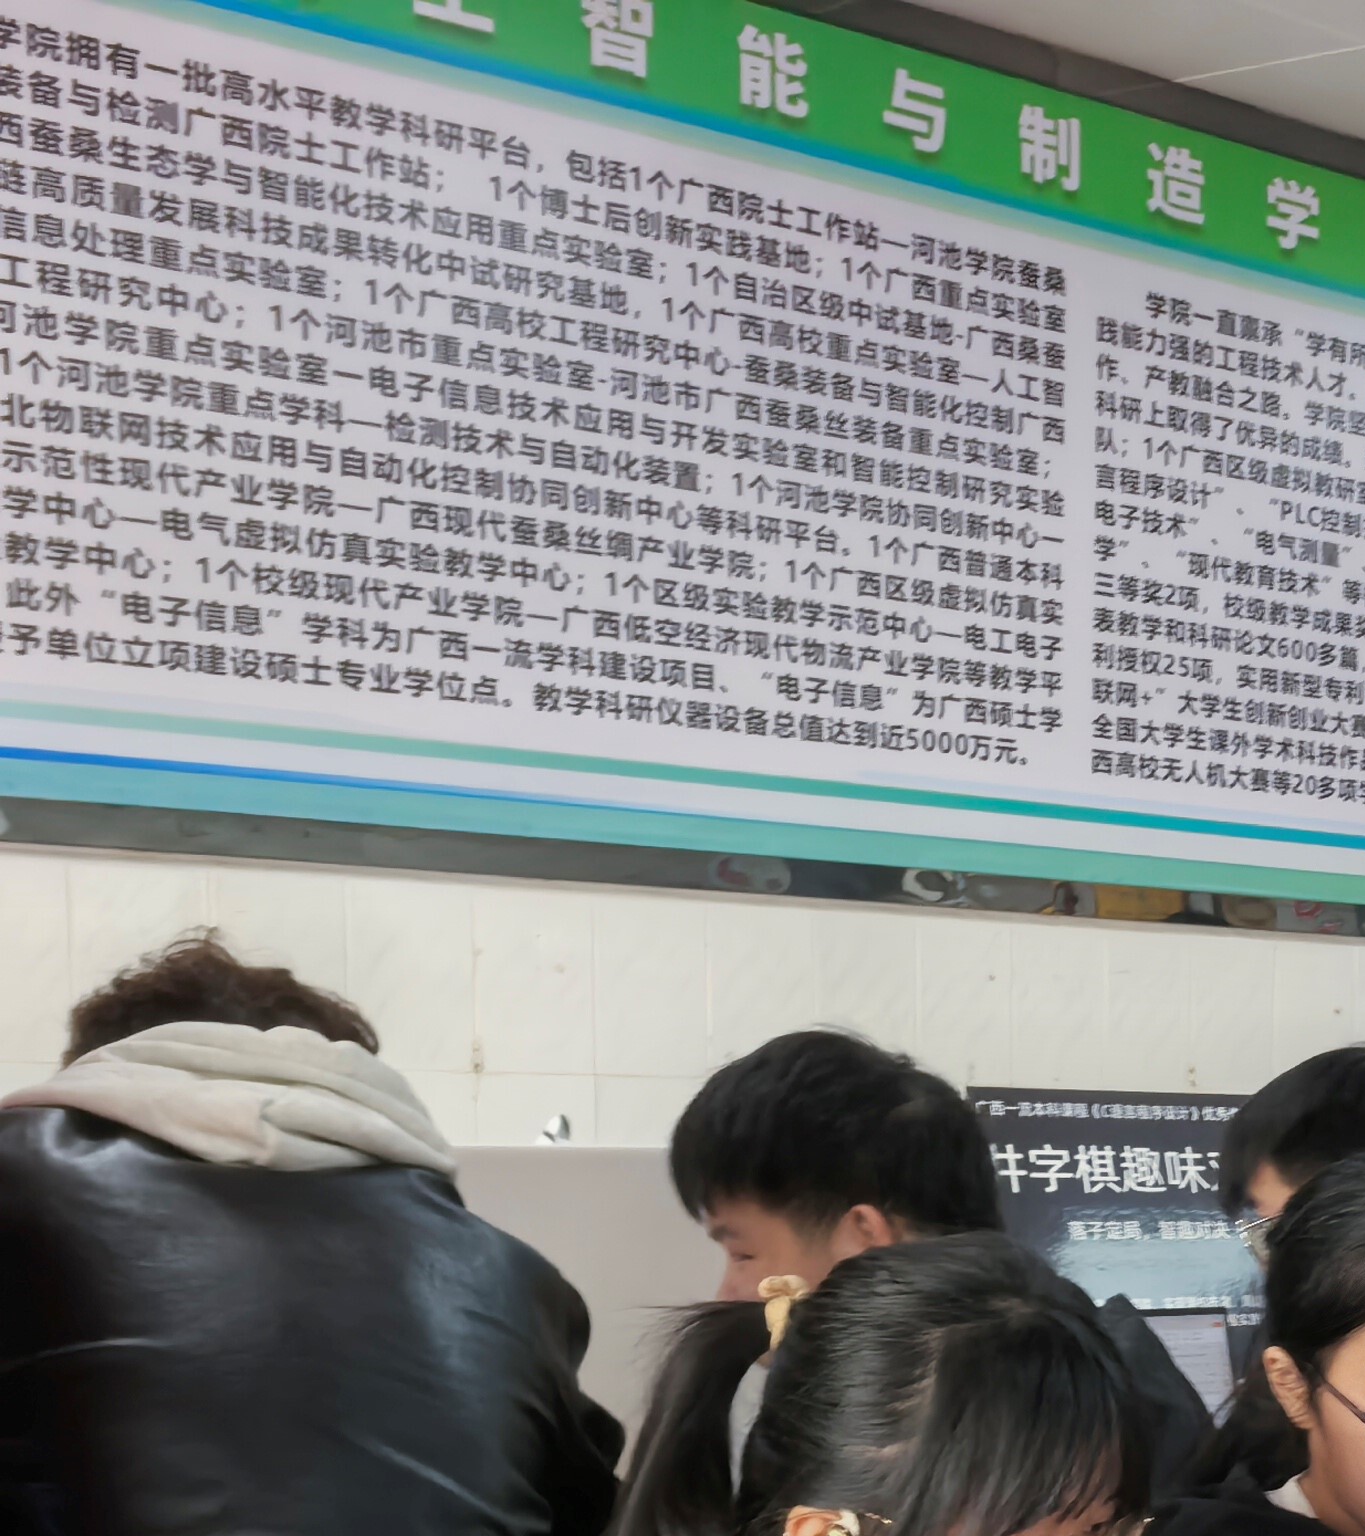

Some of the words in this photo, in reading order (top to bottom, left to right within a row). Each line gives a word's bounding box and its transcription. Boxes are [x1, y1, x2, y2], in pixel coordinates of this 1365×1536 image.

[0, 622, 1027, 765] 予单位立项建设硕士专业学位点。教学科研仪器设备总值达到近5000万元。
